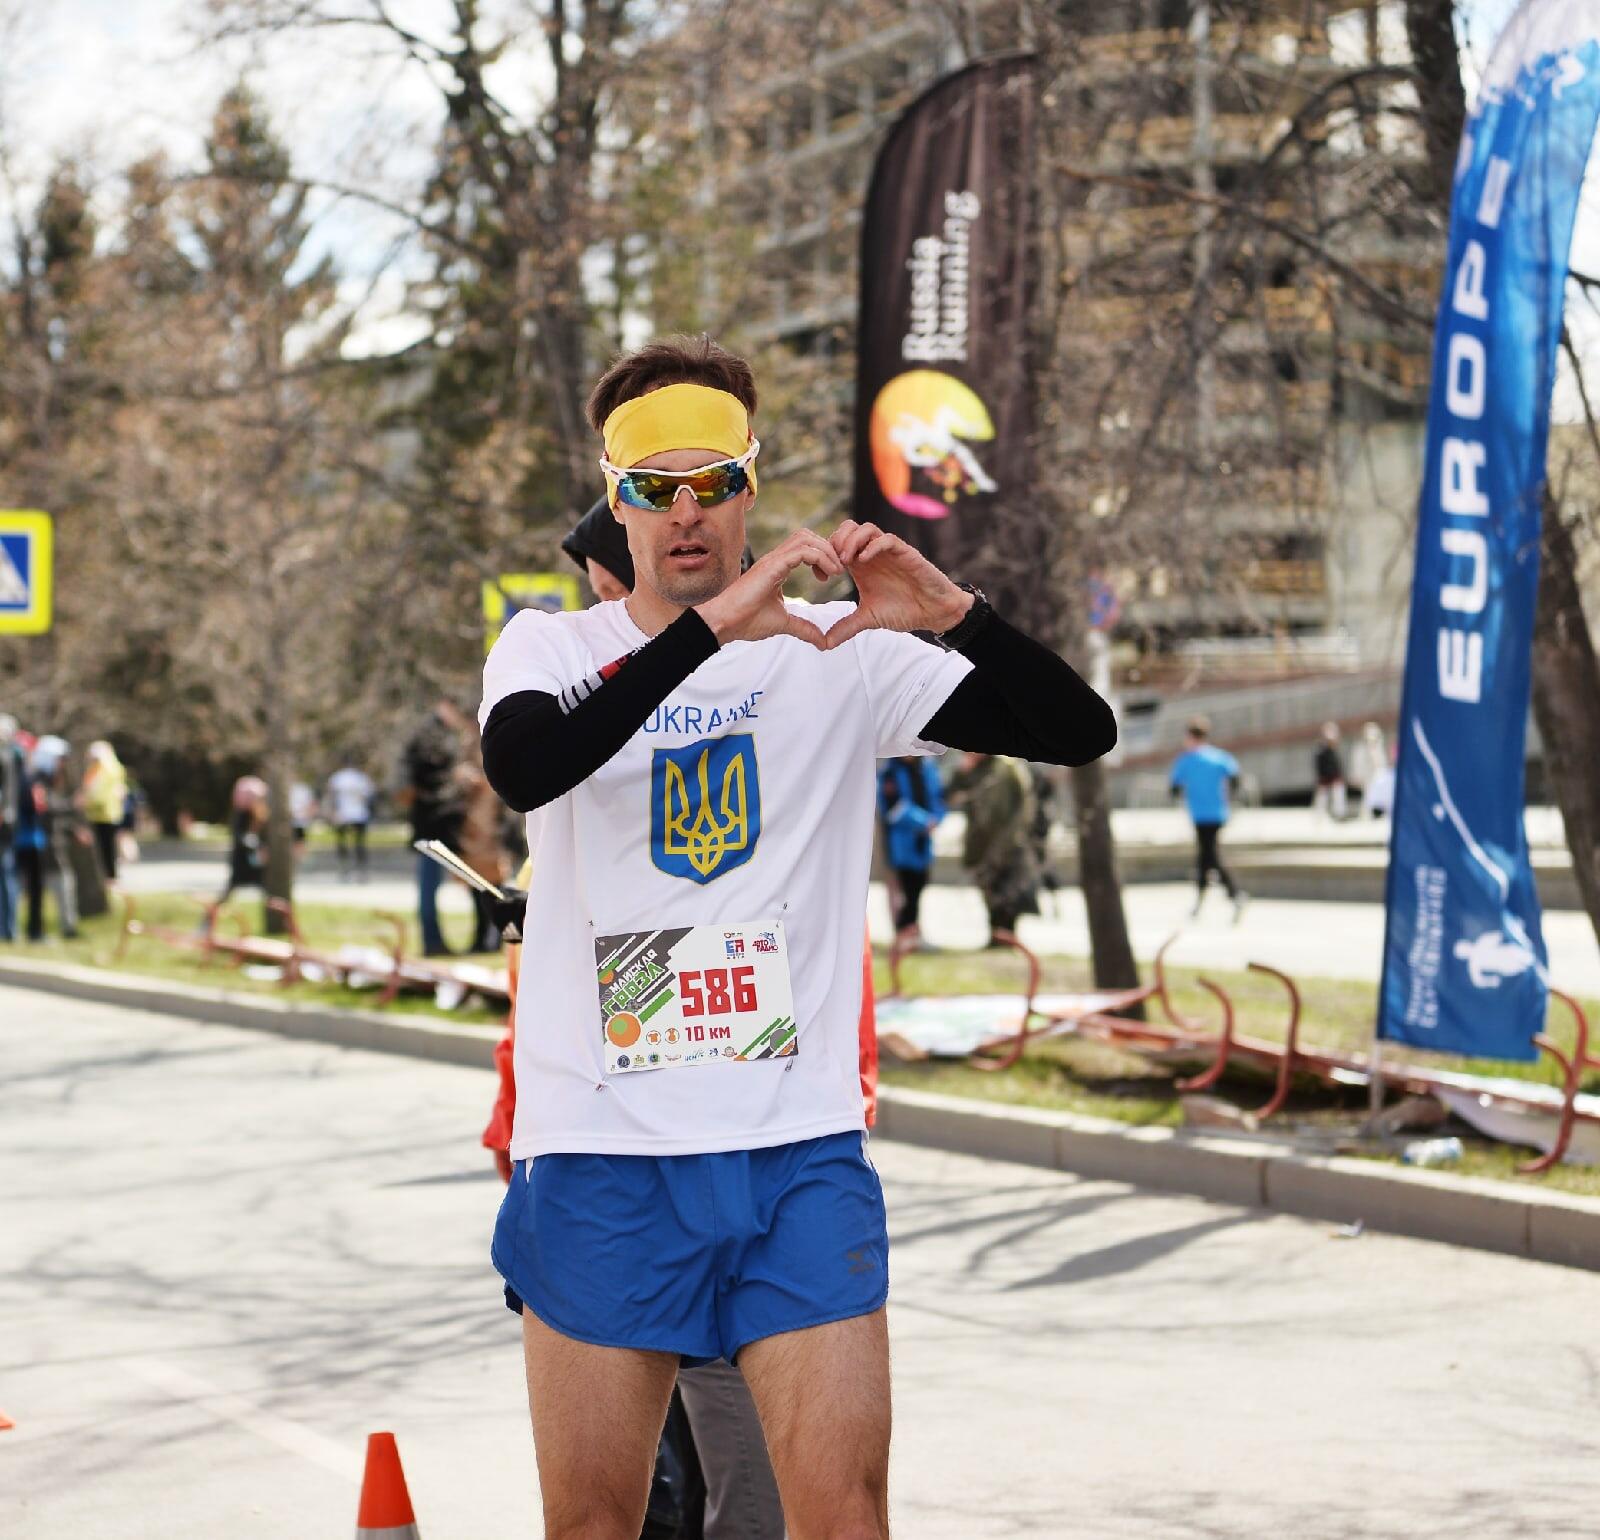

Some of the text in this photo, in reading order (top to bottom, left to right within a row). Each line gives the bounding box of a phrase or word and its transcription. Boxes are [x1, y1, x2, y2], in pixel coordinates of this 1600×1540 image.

[901, 236, 940, 361] Russia
[936, 191, 980, 361] Running
[679, 965, 758, 1018] 586
[685, 1025, 705, 1042] 10
